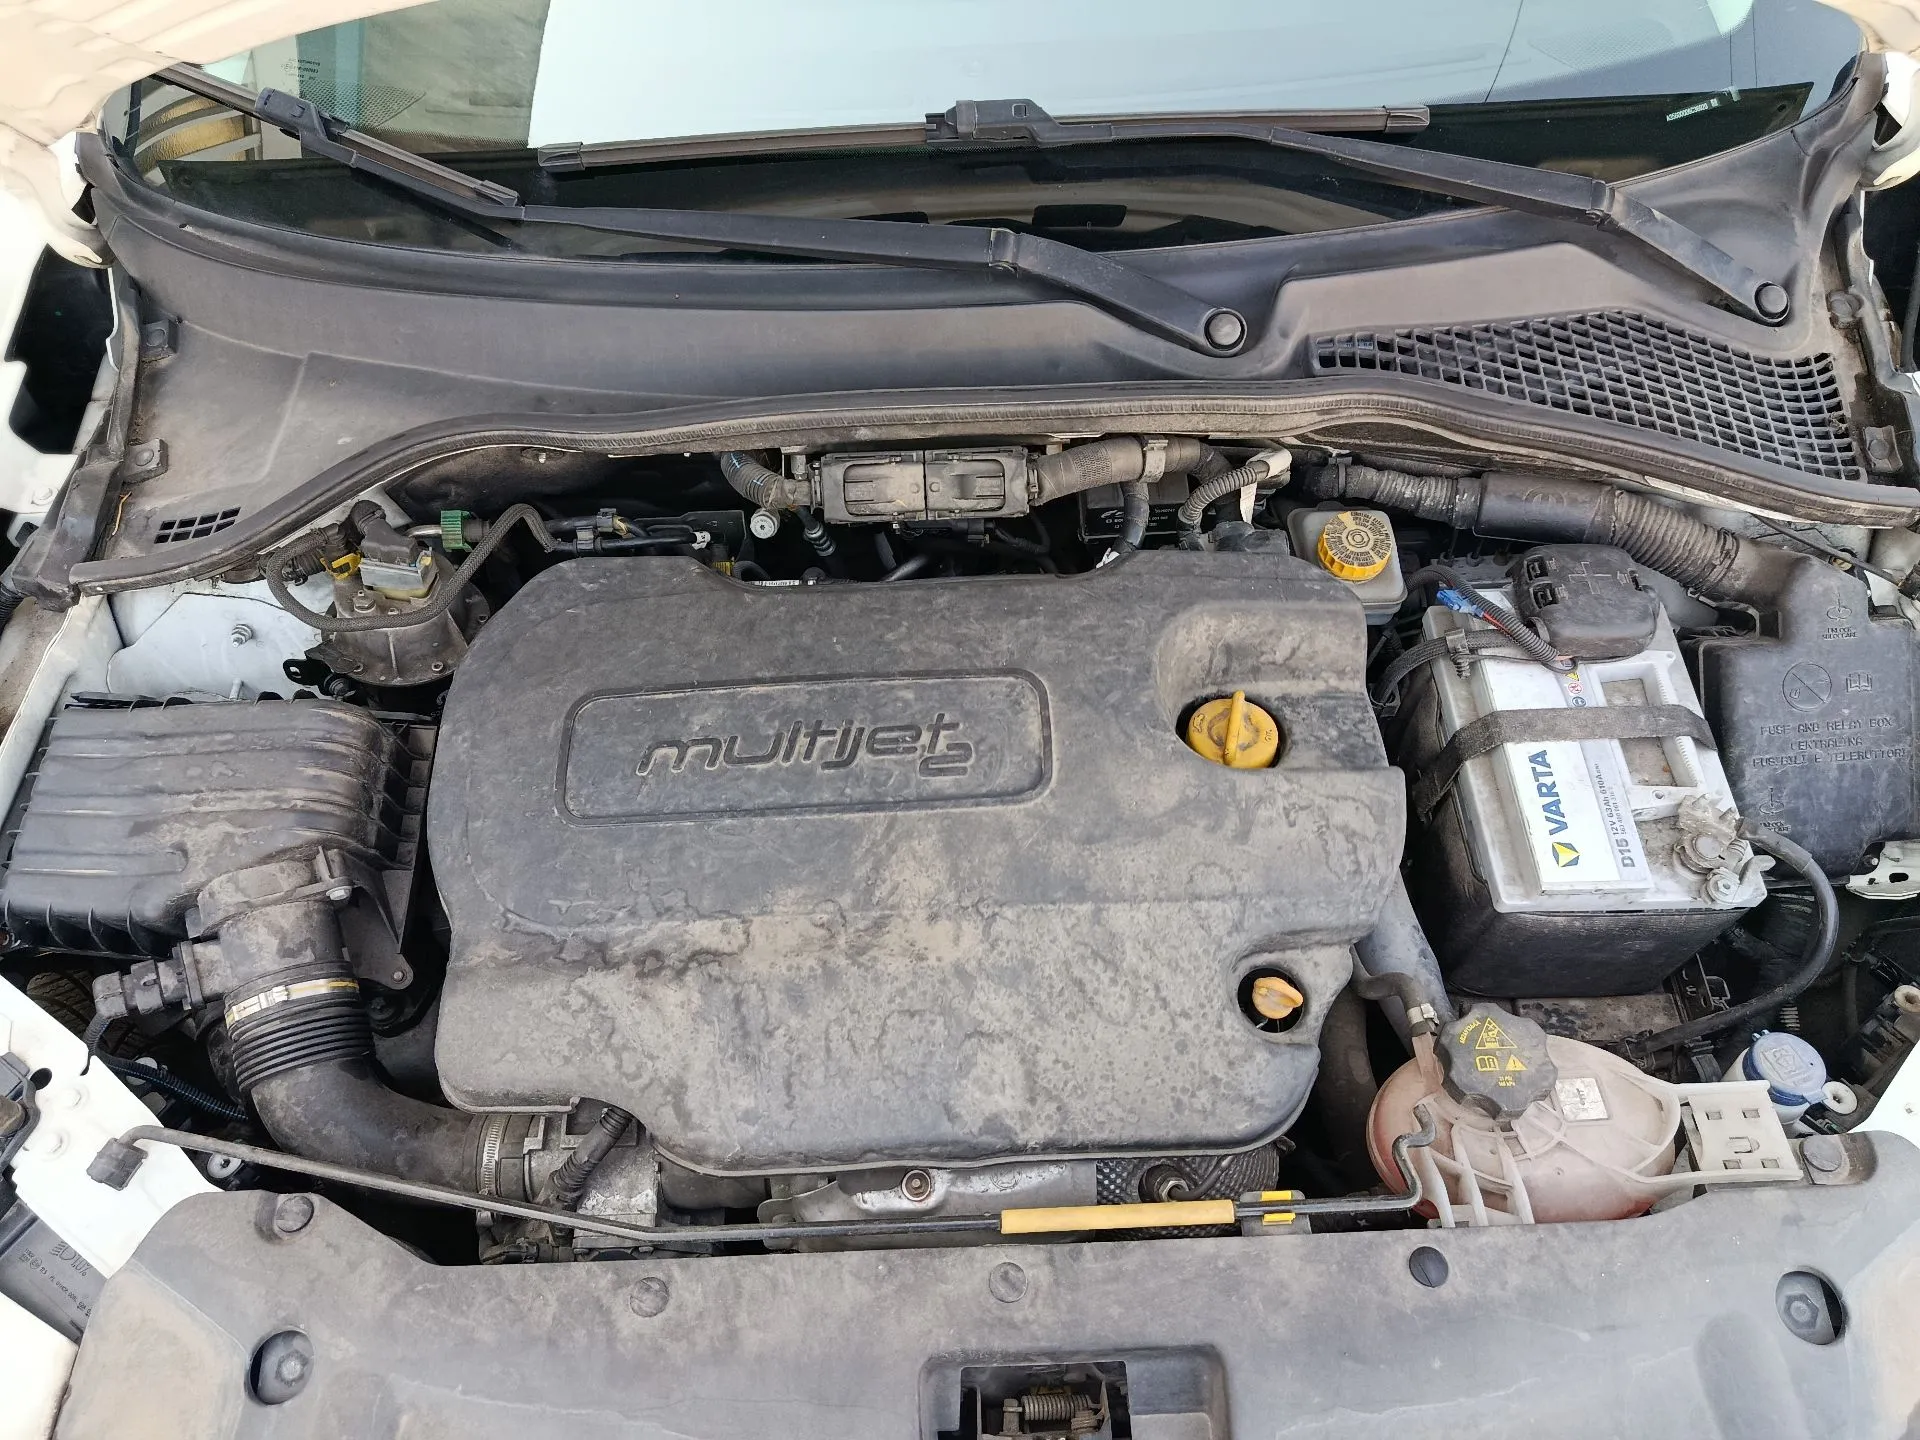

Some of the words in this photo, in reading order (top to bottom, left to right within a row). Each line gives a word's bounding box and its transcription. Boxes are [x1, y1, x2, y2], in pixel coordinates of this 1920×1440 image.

[1760, 724, 1791, 736] FUSE
[1797, 722, 1820, 733] AND
[1826, 719, 1862, 731] RELAY
[1869, 717, 1893, 728] BOX
[635, 712, 961, 776] multijet
[1790, 736, 1863, 751] CENTRALINA
[1752, 754, 1807, 767] FUSIBILI
[1814, 754, 1822, 763] E
[1829, 748, 1906, 762] TELERUTTORI
[1528, 749, 1569, 836] VARTA
[1608, 819, 1620, 836] 12V
[1618, 838, 1635, 868] D15
